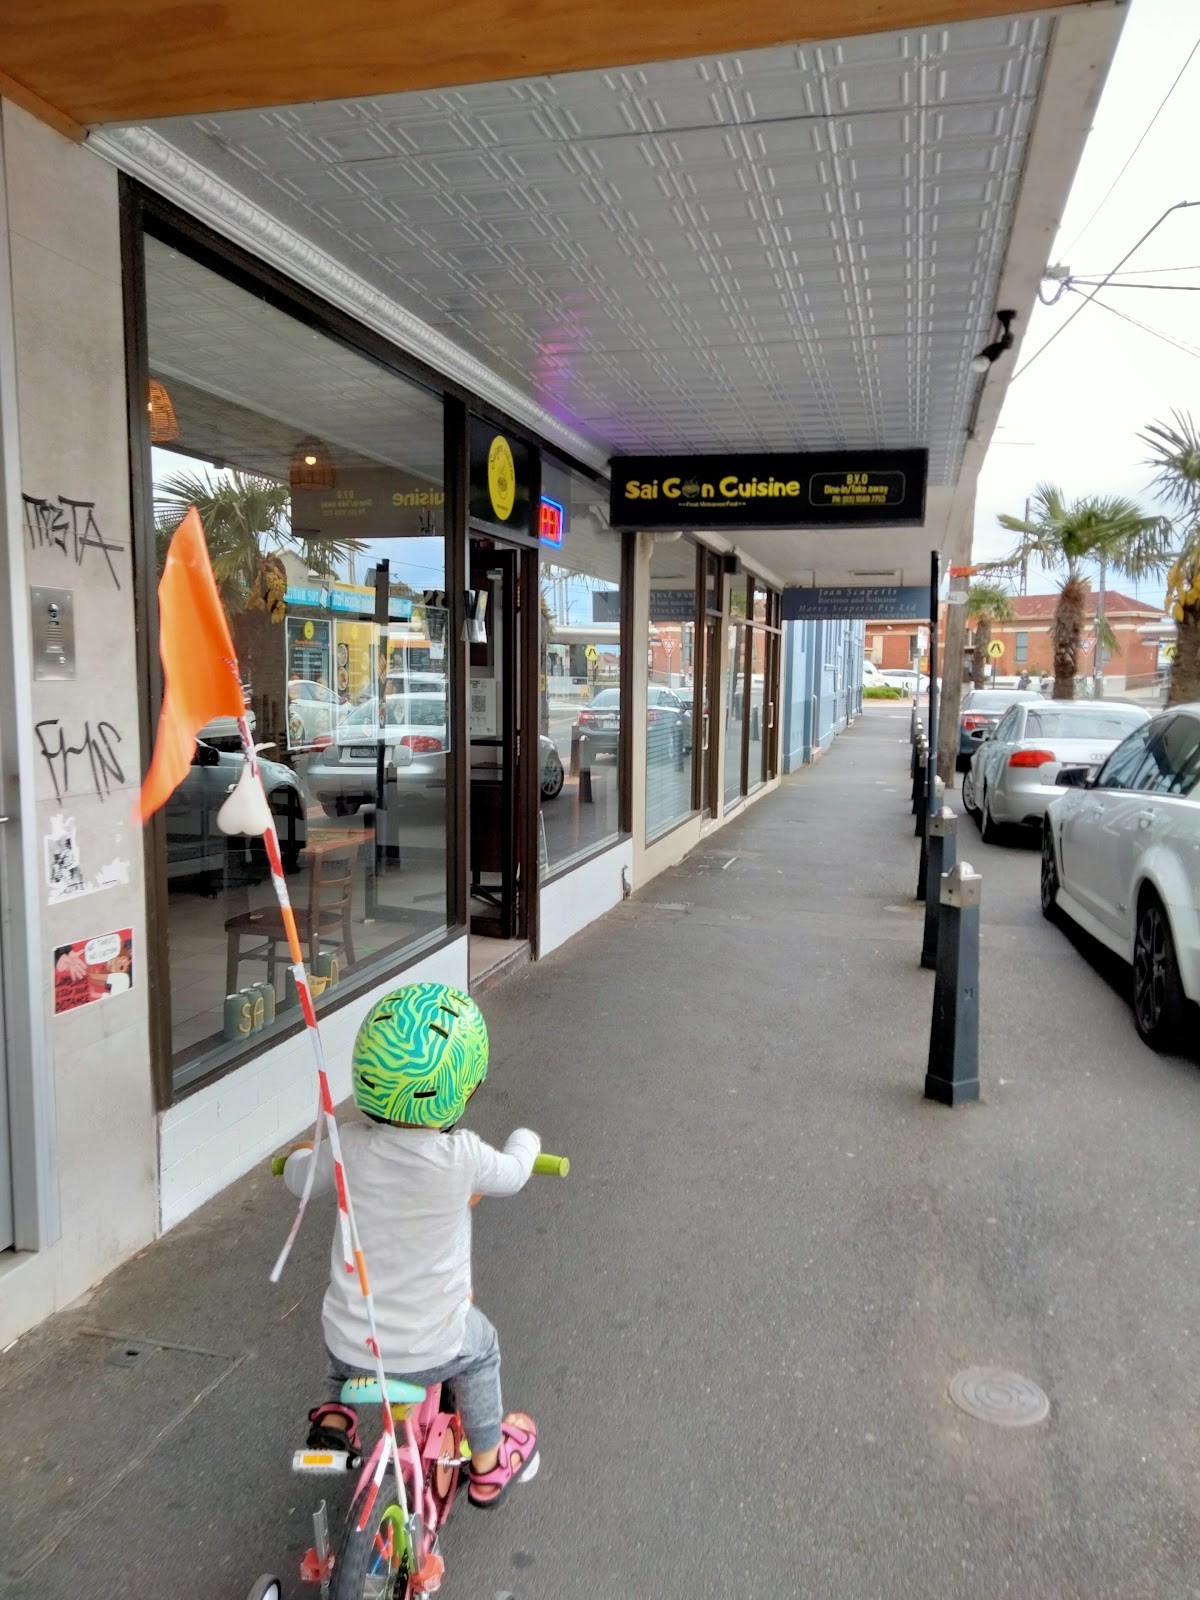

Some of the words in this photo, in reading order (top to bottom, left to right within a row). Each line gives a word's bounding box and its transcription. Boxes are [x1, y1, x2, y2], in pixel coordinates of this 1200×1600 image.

[625, 479, 658, 499] Sai
[719, 476, 800, 498] Cuisine
[877, 603, 895, 613] Pty
[900, 603, 918, 612] Ltd
